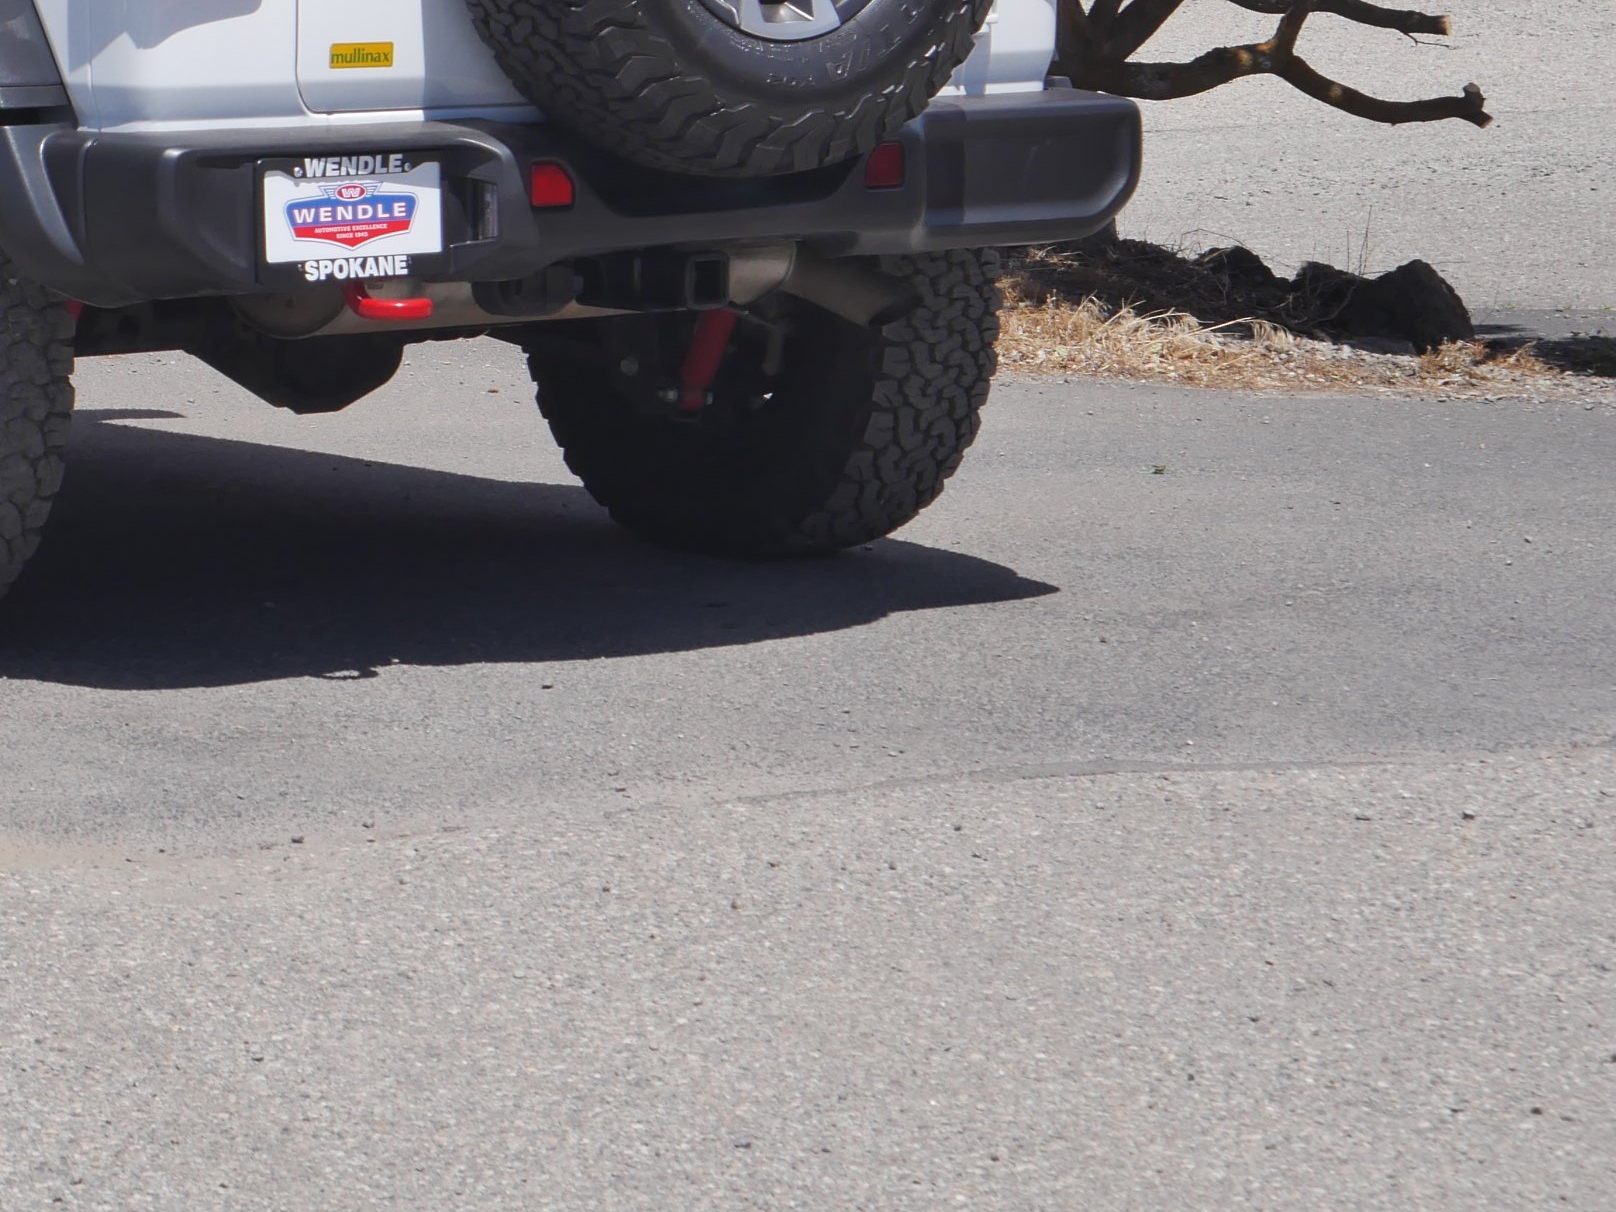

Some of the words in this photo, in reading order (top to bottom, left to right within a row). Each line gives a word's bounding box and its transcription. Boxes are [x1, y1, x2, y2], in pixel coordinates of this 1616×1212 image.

[331, 48, 390, 64] mullinax
[304, 153, 404, 178] WENDLE
[293, 202, 407, 224] WENDLE
[314, 225, 351, 234] AUTOMOTIVE
[304, 255, 409, 282] SPOKANE
